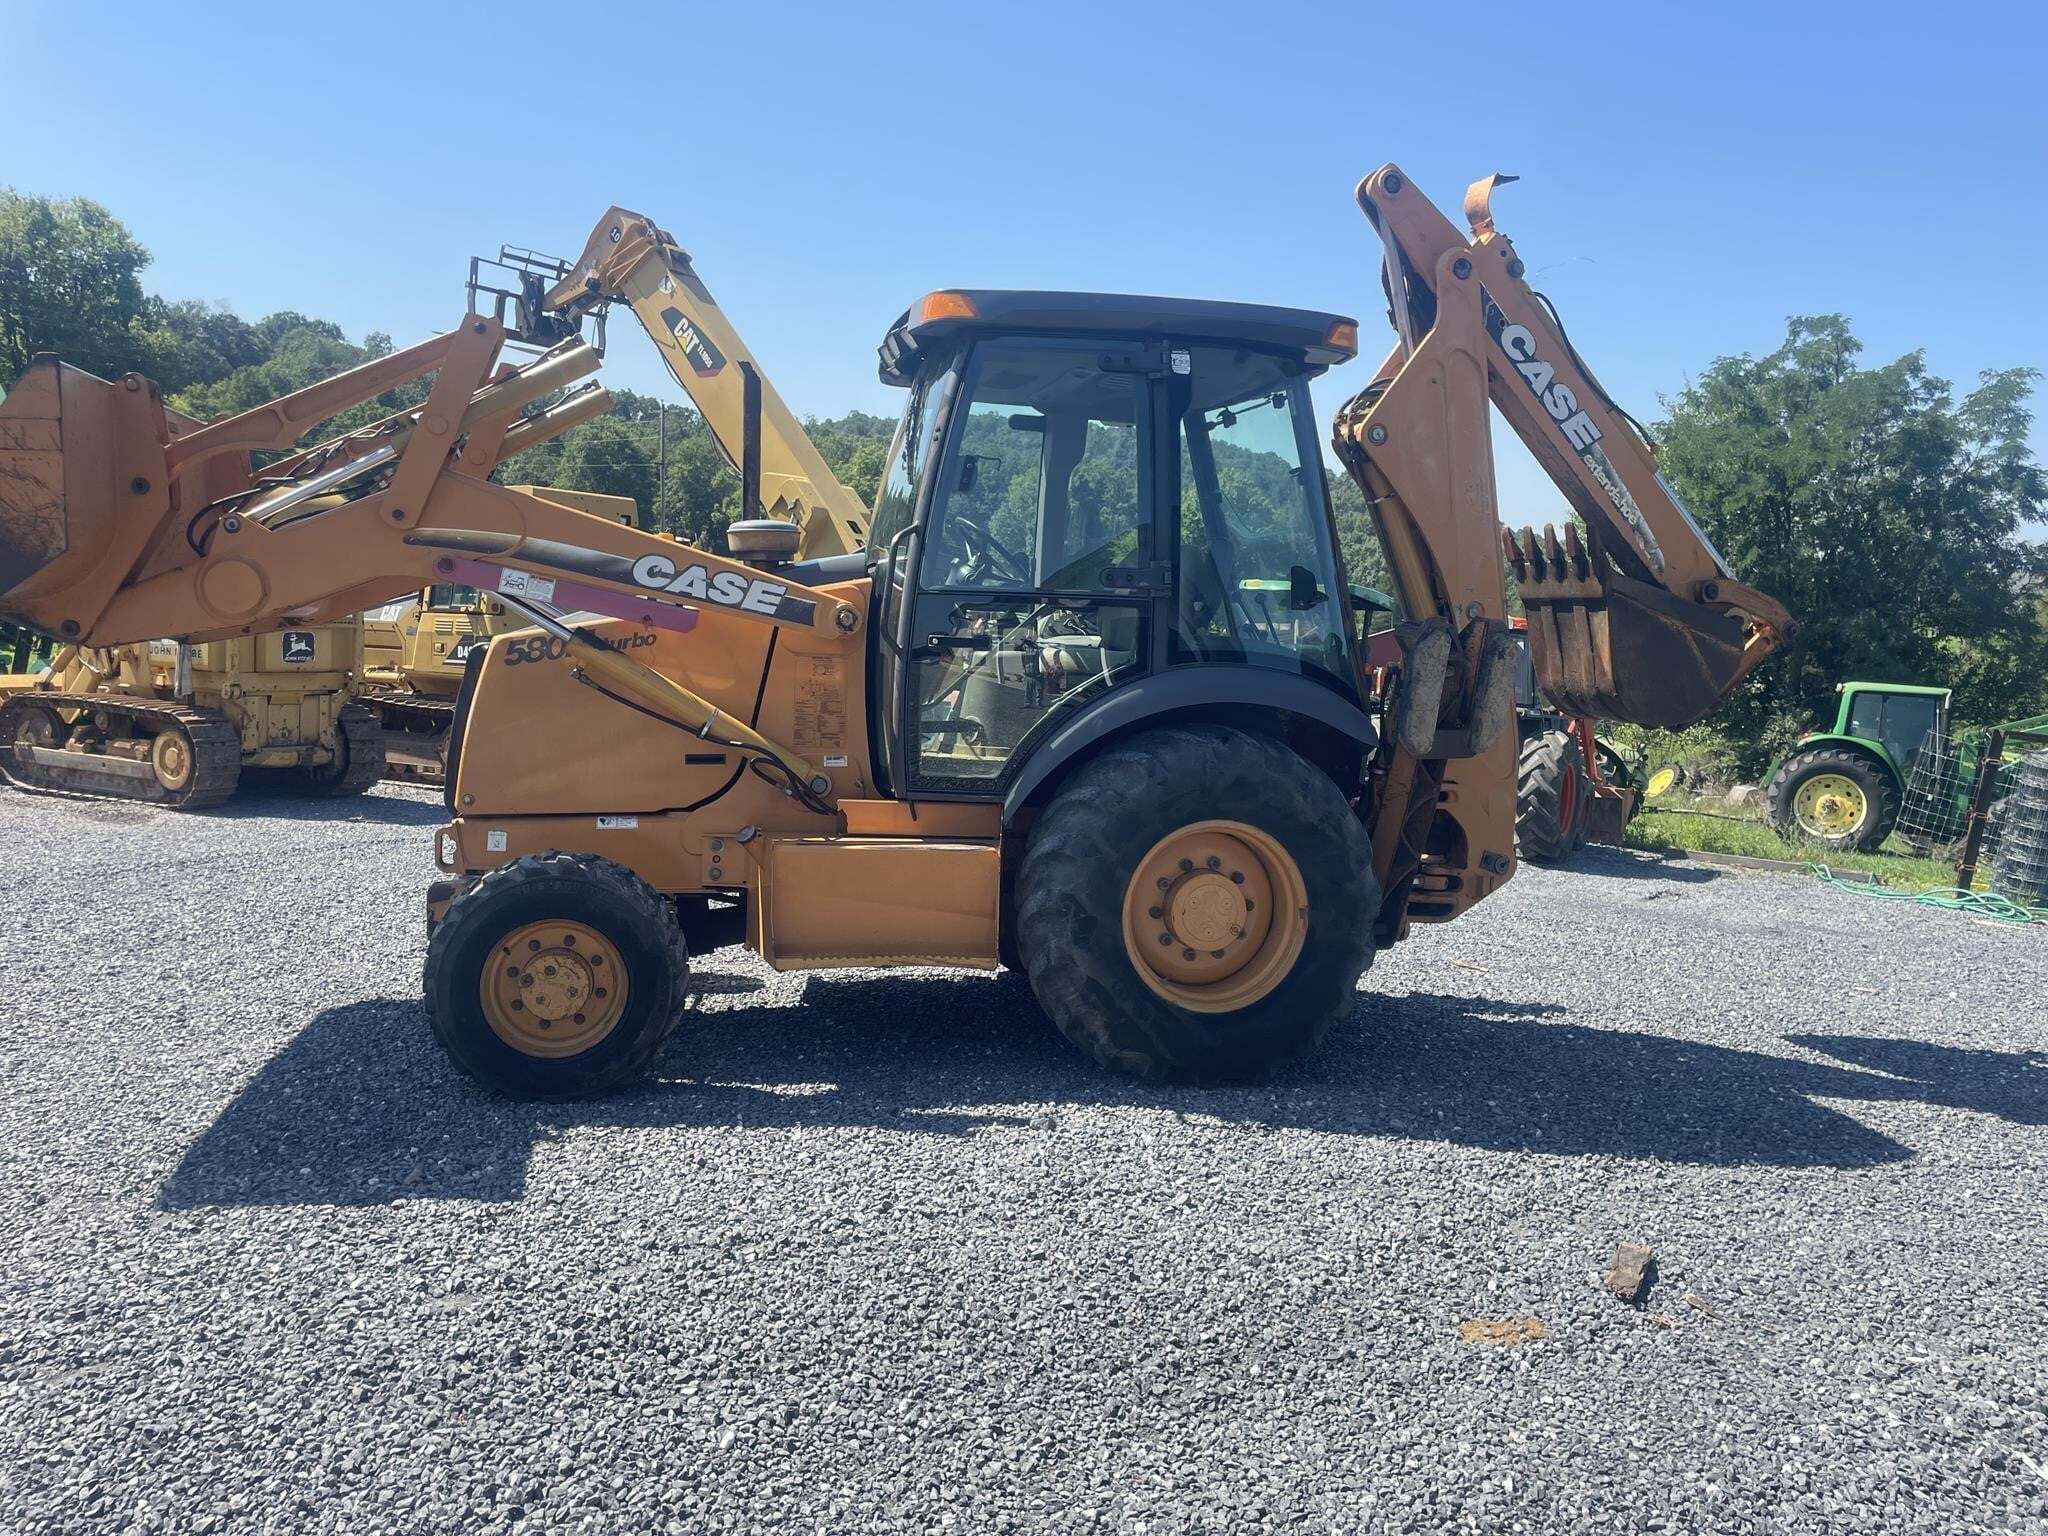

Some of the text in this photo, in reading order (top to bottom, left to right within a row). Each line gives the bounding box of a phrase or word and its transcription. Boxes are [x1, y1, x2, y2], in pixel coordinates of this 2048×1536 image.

[673, 317, 700, 354] CAT
[1501, 324, 1603, 451] CASE
[632, 554, 788, 616] CASE
[380, 605, 402, 621] CAT
[149, 645, 172, 656] JOHN
